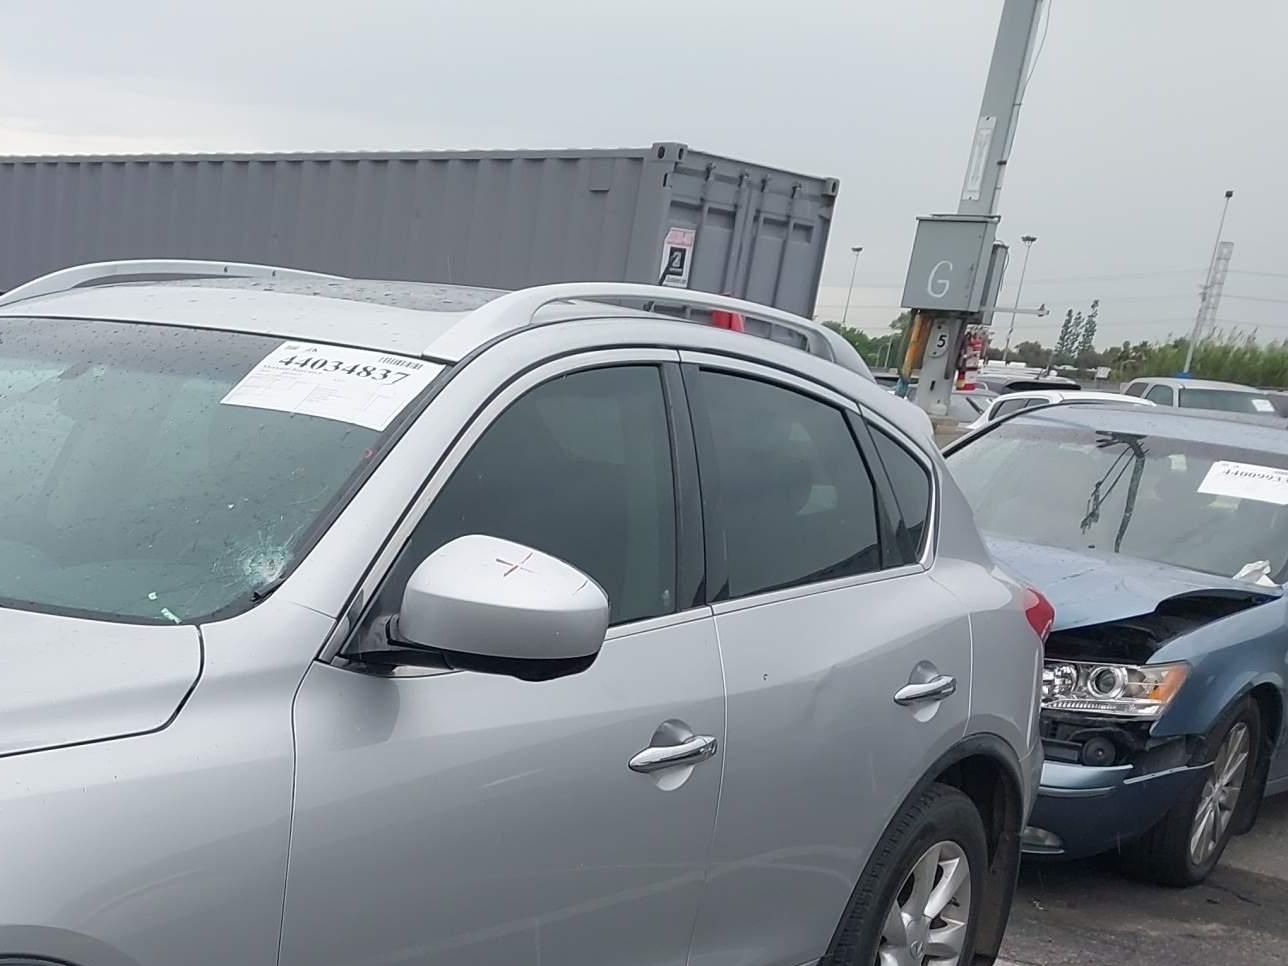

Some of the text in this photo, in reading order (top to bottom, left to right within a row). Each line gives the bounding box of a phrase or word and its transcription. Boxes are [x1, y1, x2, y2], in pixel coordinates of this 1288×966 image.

[927, 260, 954, 298] G
[936, 334, 948, 348] 5
[278, 354, 411, 386] 44034837
